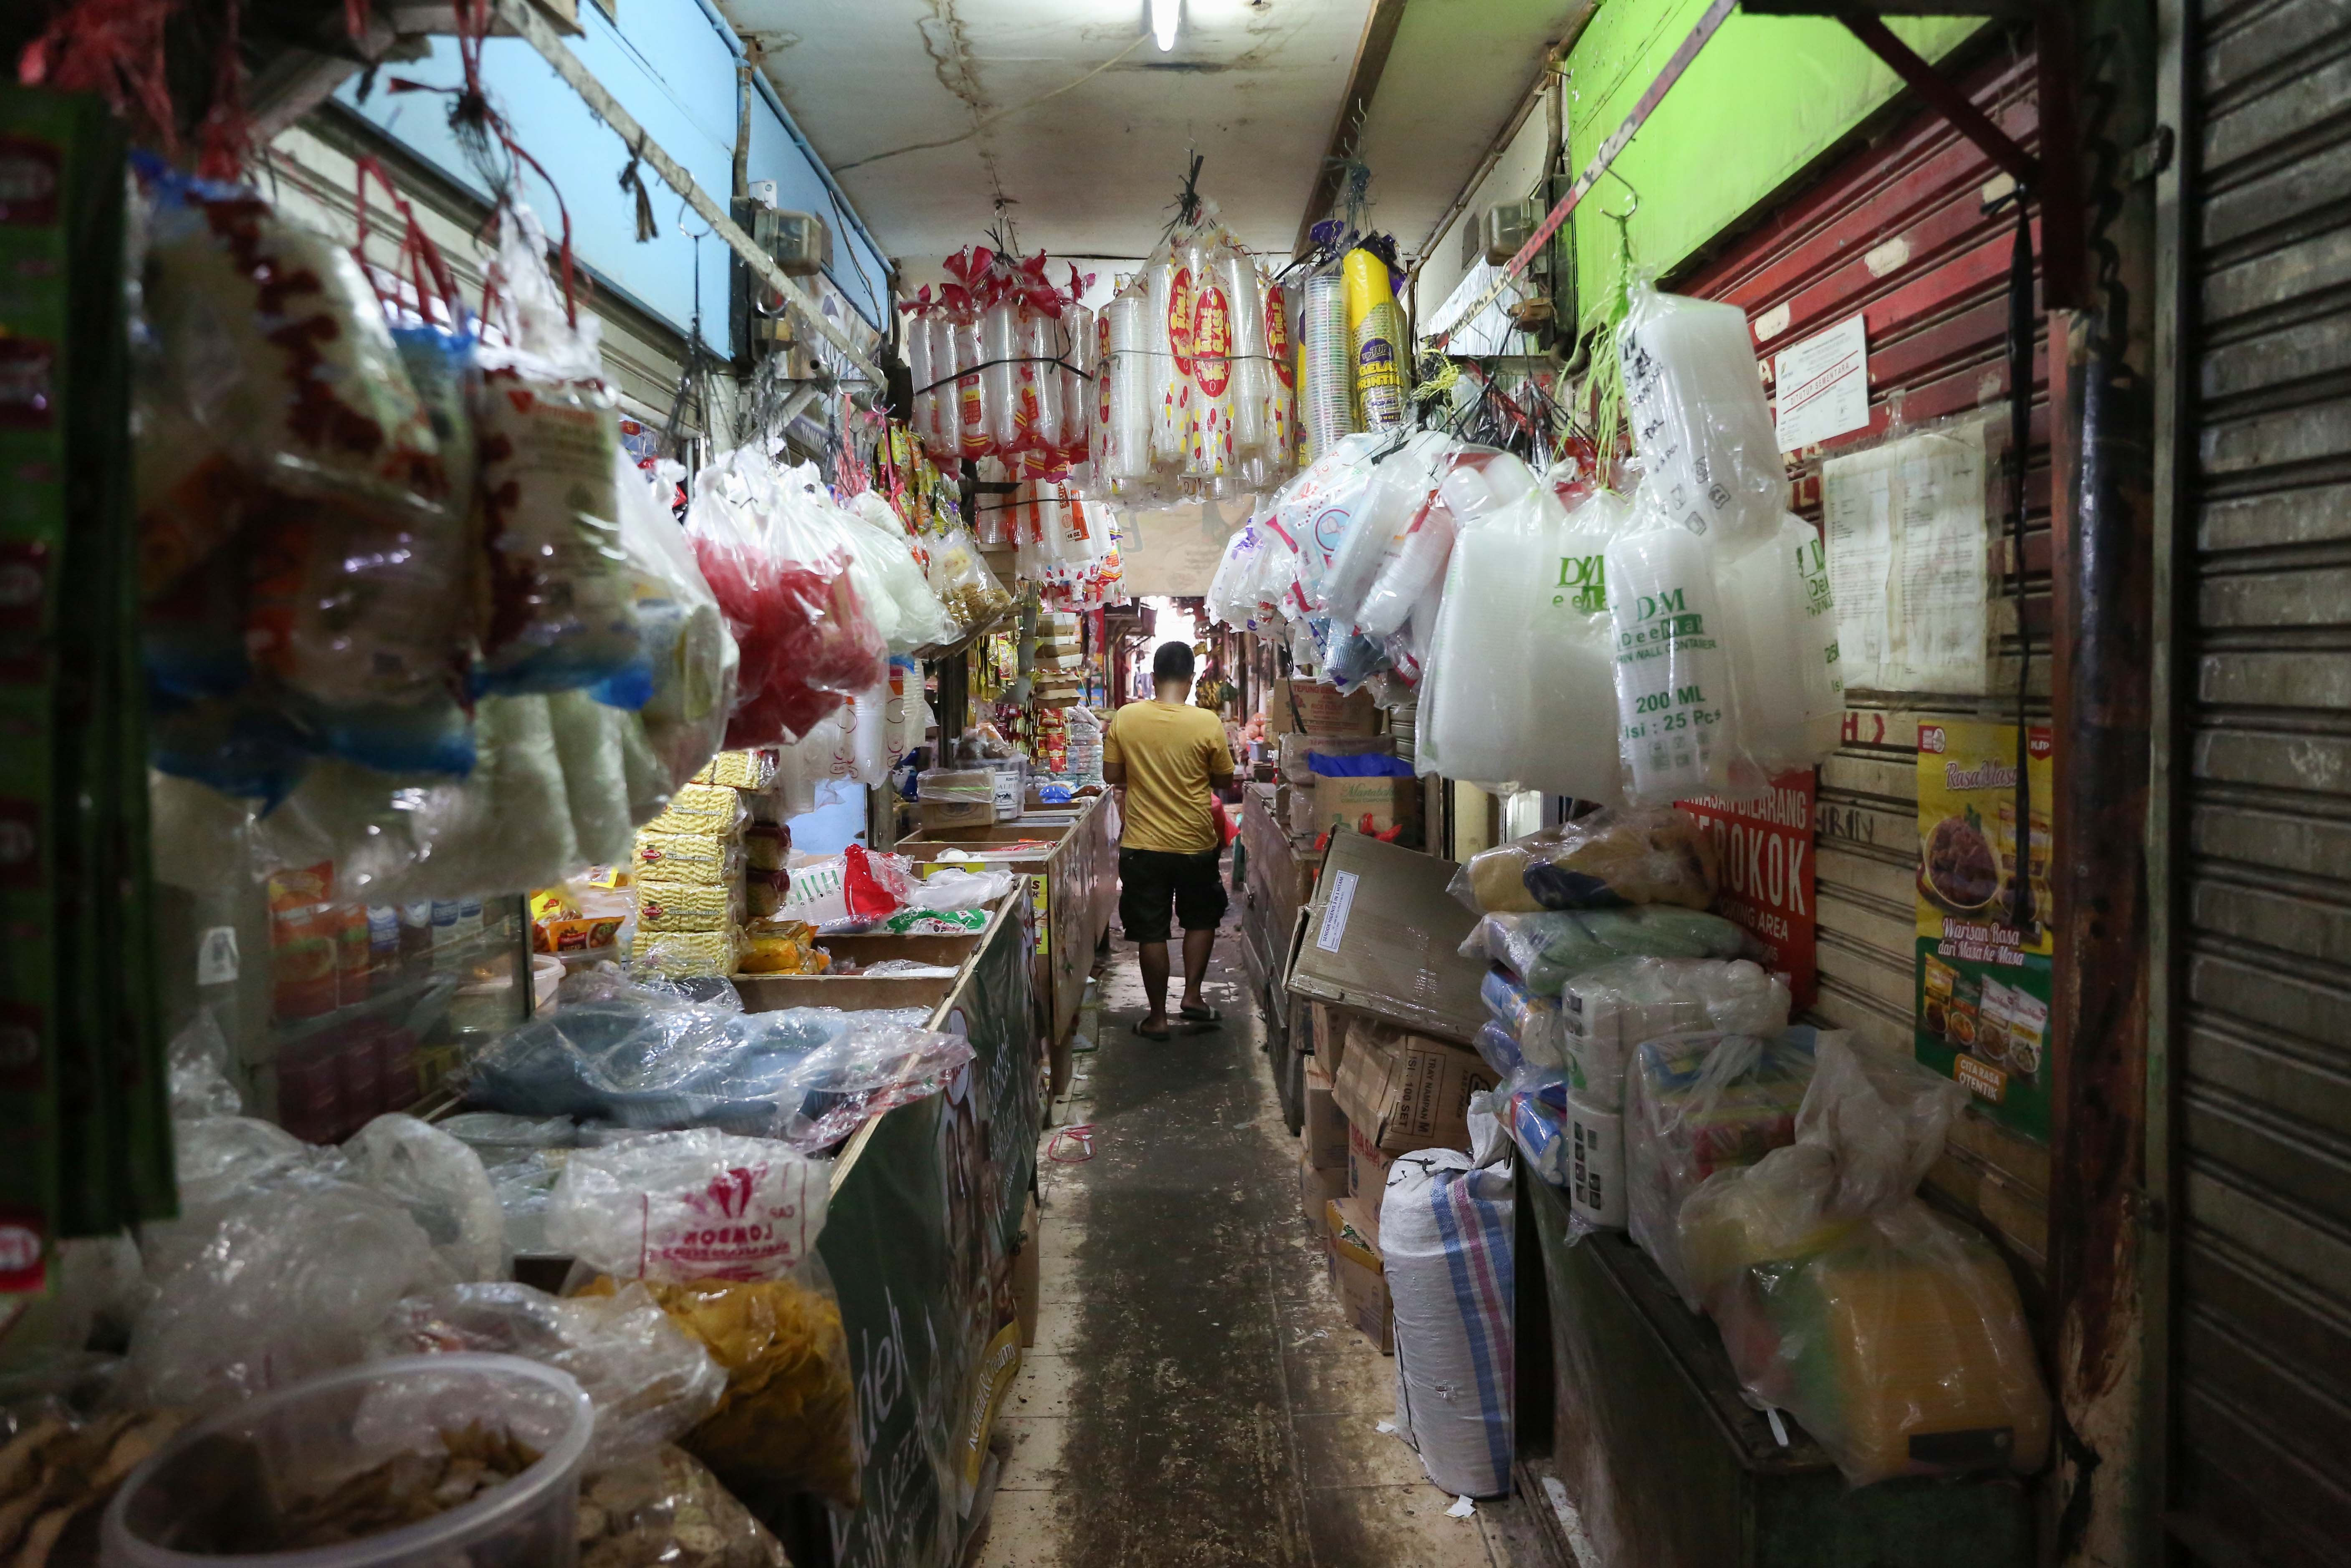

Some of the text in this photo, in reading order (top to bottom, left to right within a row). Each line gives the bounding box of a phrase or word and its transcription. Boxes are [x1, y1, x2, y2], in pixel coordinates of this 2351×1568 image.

[1370, 344, 1388, 355] TOP
[1359, 361, 1398, 377] GELAS
[1790, 385, 1813, 405] DITUTUP
[1815, 362, 1849, 389] SEMENTARA
[1636, 588, 1686, 621] DM
[1294, 684, 1319, 693] TEPUNG
[1636, 685, 1706, 713] 200 ML
[1625, 722, 1645, 739] Isi
[1663, 712, 1687, 731] 25
[1693, 709, 1721, 726] Pcs
[1946, 762, 1979, 789] Rasa
[1737, 786, 1806, 830] DILARANG
[1691, 812, 1805, 915] ROKOK
[1322, 923, 1331, 942] SENDOK
[1327, 904, 1336, 923] HIGENIS
[1757, 911, 1789, 942] AREA
[1943, 918, 2020, 946] Warisan Rasa
[1938, 940, 2025, 966] dari Masa ke Masa
[1408, 1057, 1417, 1070] ISI
[1961, 1059, 1999, 1087] CITA RASA
[1403, 1082, 1413, 1100] 100
[1419, 1058, 1436, 1132] TRAY NAMPAN M
[1959, 1071, 1998, 1101] OTENTIK
[1399, 1105, 1409, 1128] SET
